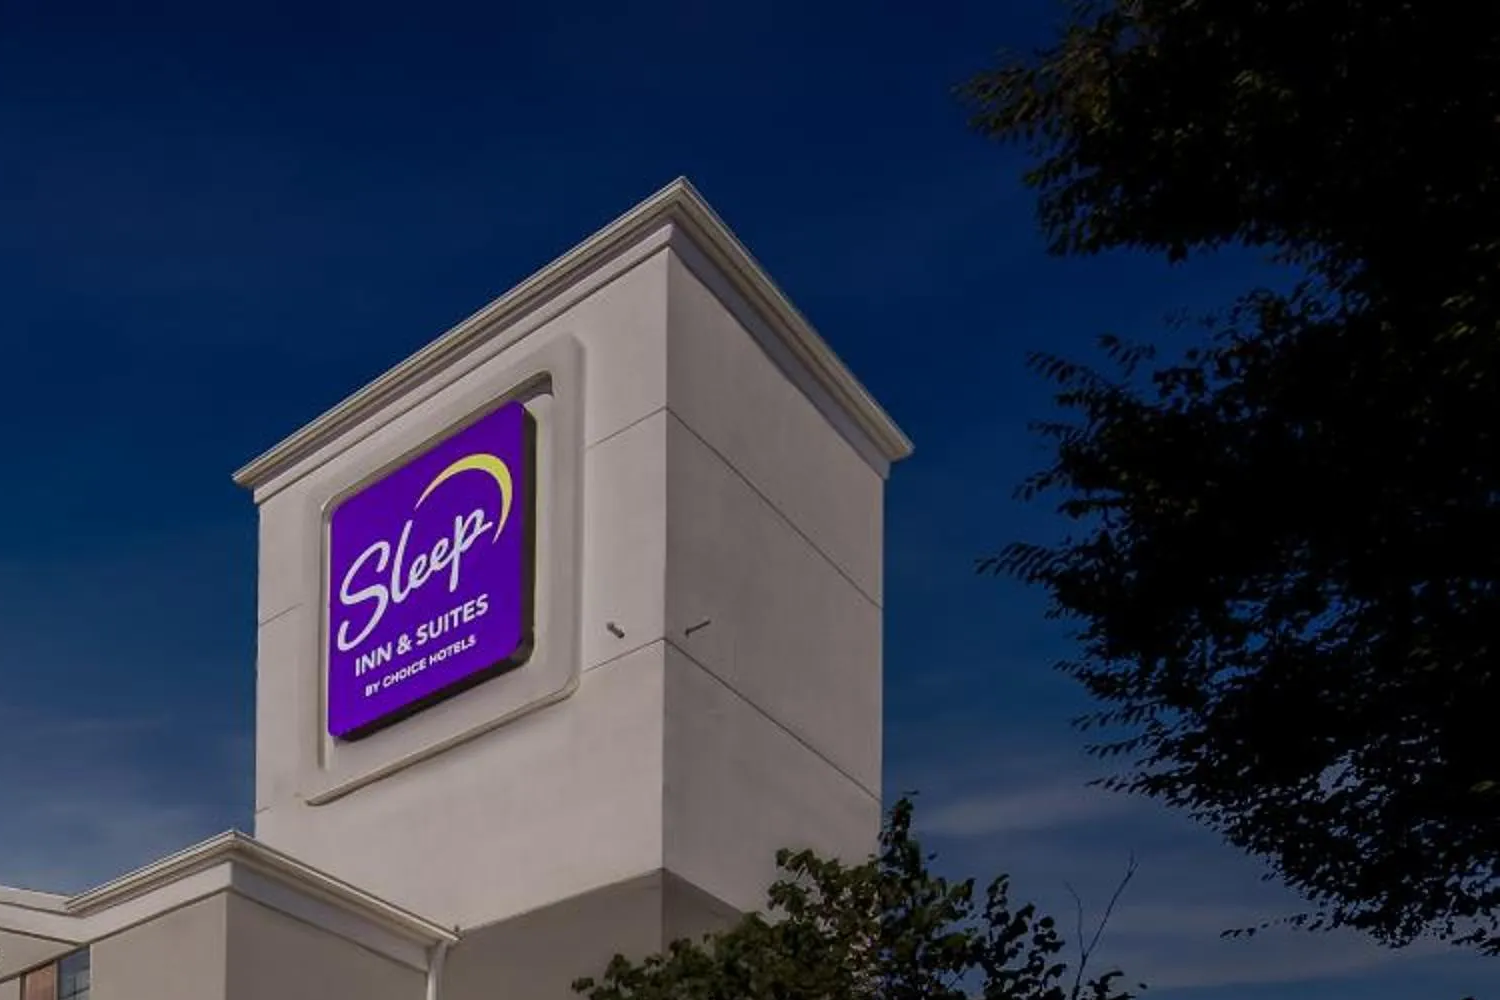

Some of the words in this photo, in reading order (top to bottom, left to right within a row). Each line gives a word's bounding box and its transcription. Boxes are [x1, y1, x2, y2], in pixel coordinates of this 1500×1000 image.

[337, 508, 493, 651] Sleep
[355, 645, 392, 677] INN
[396, 633, 411, 655] &
[416, 594, 489, 646] SUITES
[365, 681, 380, 696] BY
[383, 657, 427, 688] CHOICE
[429, 634, 477, 666] HOTELS
